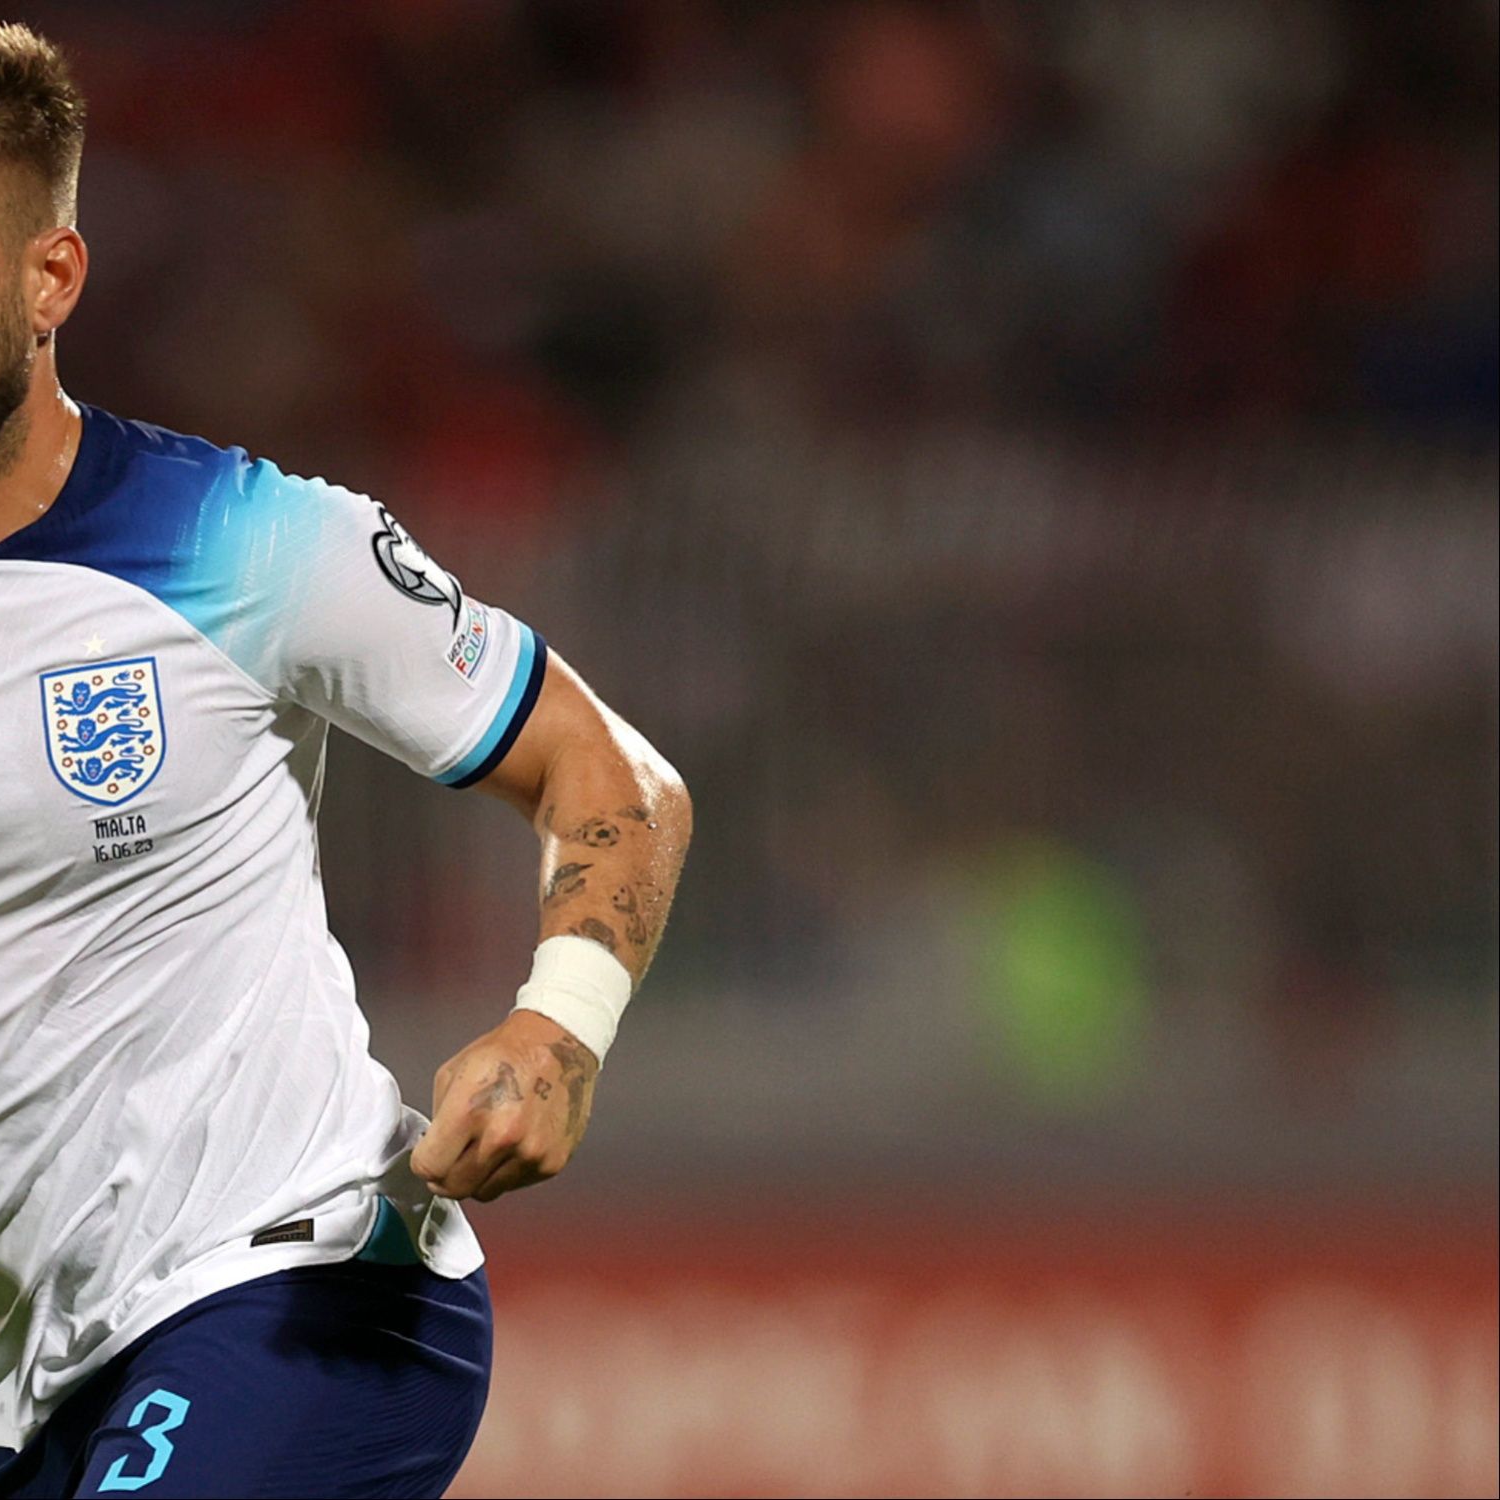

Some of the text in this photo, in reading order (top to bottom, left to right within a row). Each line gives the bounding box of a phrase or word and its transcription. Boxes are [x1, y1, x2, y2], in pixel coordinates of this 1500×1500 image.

[447, 634, 467, 663] UEFA
[93, 814, 147, 840] MALTA
[92, 838, 154, 863] 16.06.23
[96, 1388, 191, 1492] 3
